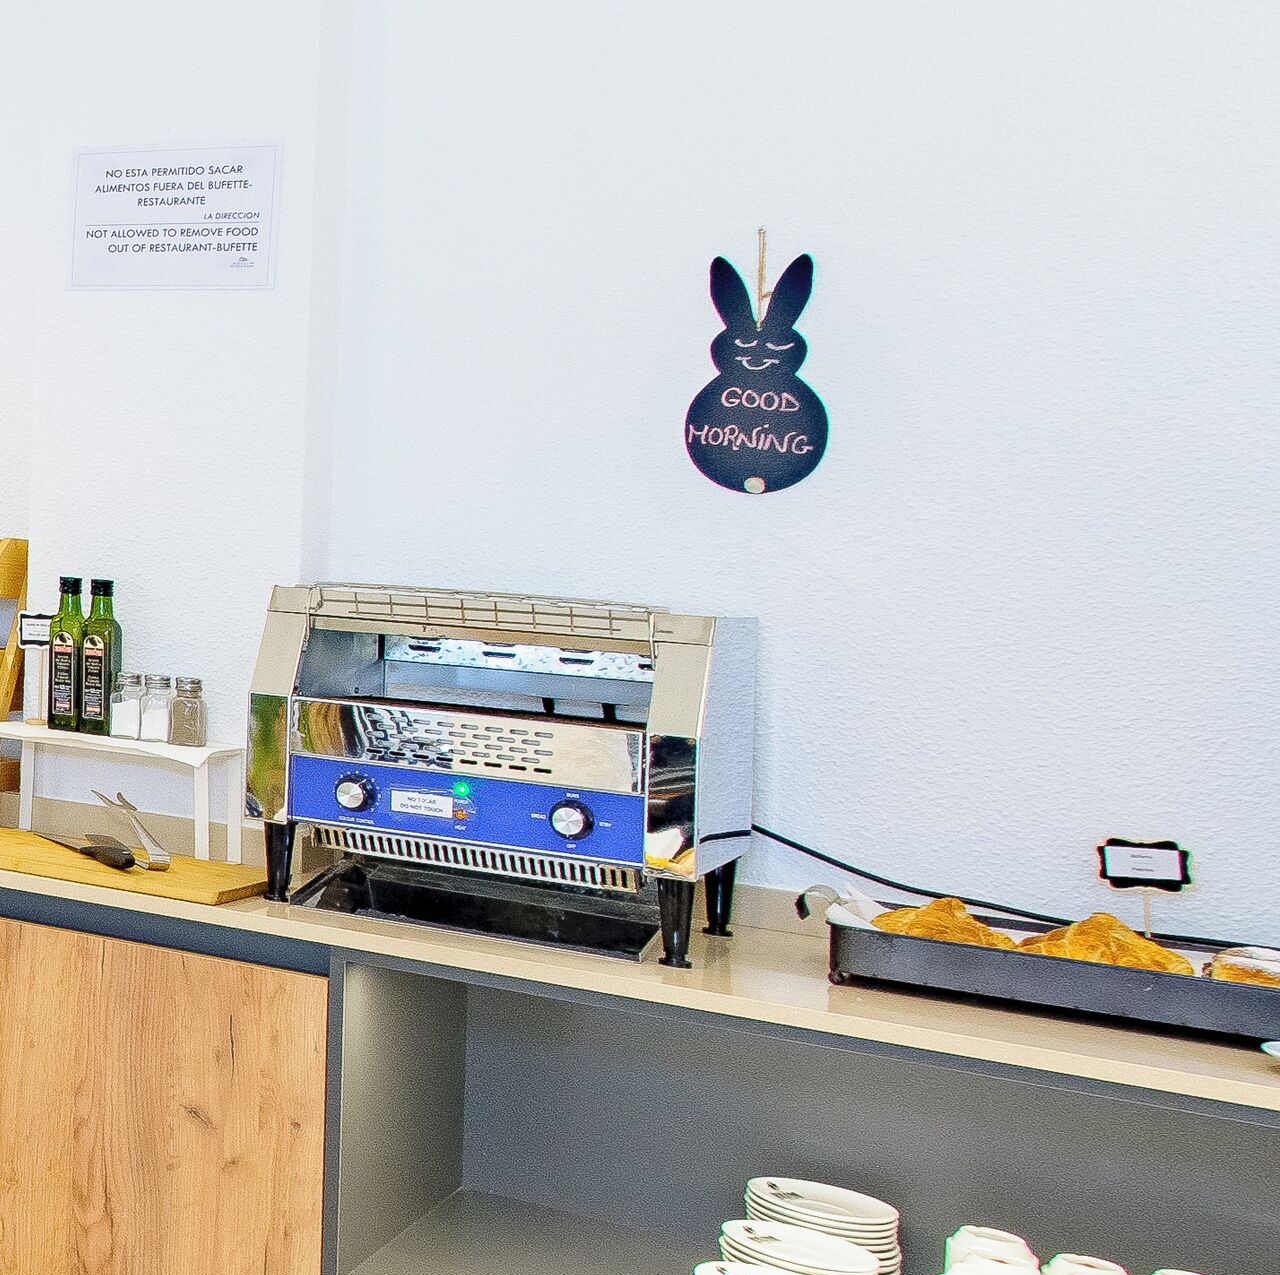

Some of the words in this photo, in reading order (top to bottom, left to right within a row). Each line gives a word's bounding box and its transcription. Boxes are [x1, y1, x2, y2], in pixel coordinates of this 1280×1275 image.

[105, 169, 123, 179] NO
[125, 168, 148, 178] ESTA
[151, 165, 205, 177] PERMITIDO
[208, 165, 243, 175] SACAR
[95, 183, 150, 193] ALIMENTOS
[153, 182, 184, 192] FUERA
[187, 181, 205, 191] DEL
[137, 196, 206, 207] RESTAURANTE
[204, 212, 213, 220] LA
[215, 211, 260, 220] DIRECCION
[86, 229, 107, 239] NOT
[110, 228, 160, 238] ALLOWED
[163, 228, 177, 238] TO
[180, 227, 223, 237] REMOVE
[226, 226, 259, 236] FOOD
[108, 244, 129, 253] OUT
[132, 243, 146, 253] OF
[149, 242, 258, 253] RESTAURANT-BUFETTE
[721, 387, 800, 411] GOOD
